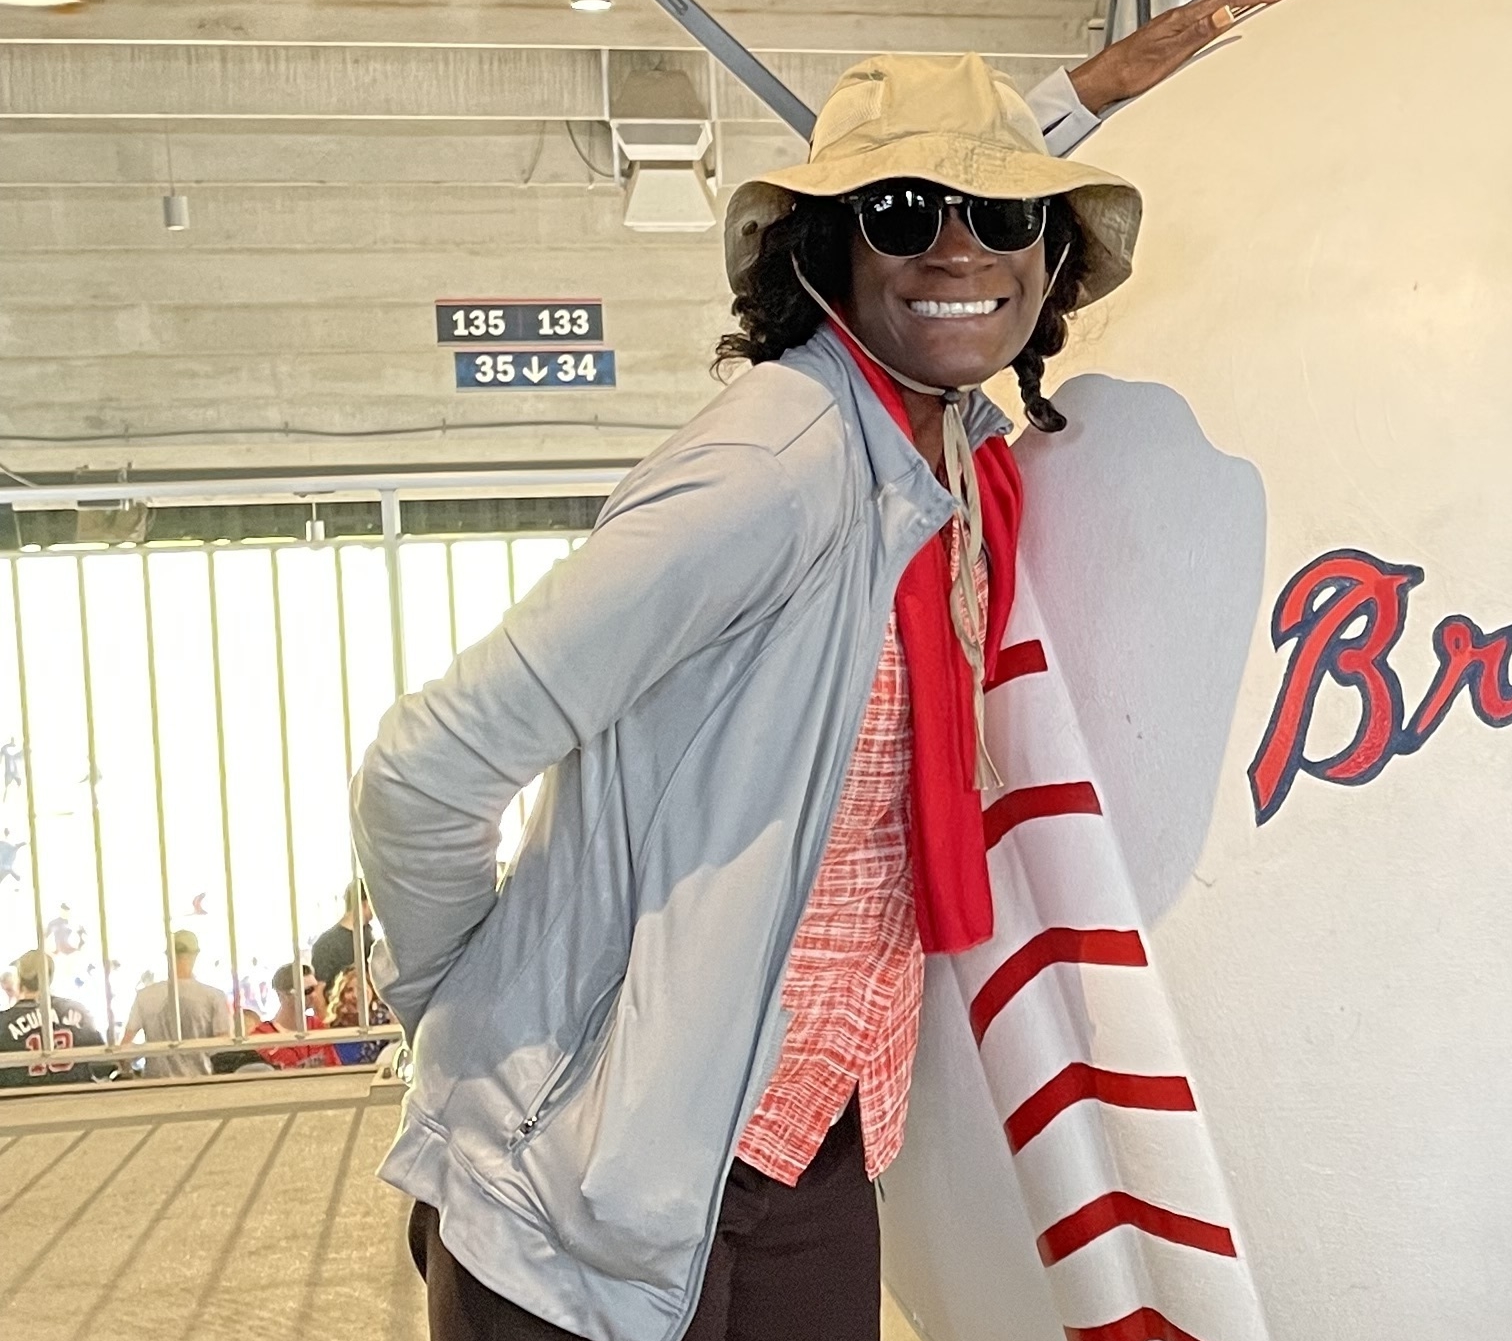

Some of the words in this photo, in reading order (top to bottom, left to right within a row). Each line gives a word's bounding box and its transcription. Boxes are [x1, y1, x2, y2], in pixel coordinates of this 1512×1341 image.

[452, 309, 506, 337] 135
[537, 309, 589, 336] 133
[474, 355, 515, 383] 35
[556, 353, 597, 382] 34
[8, 1008, 60, 1040] ACUA
